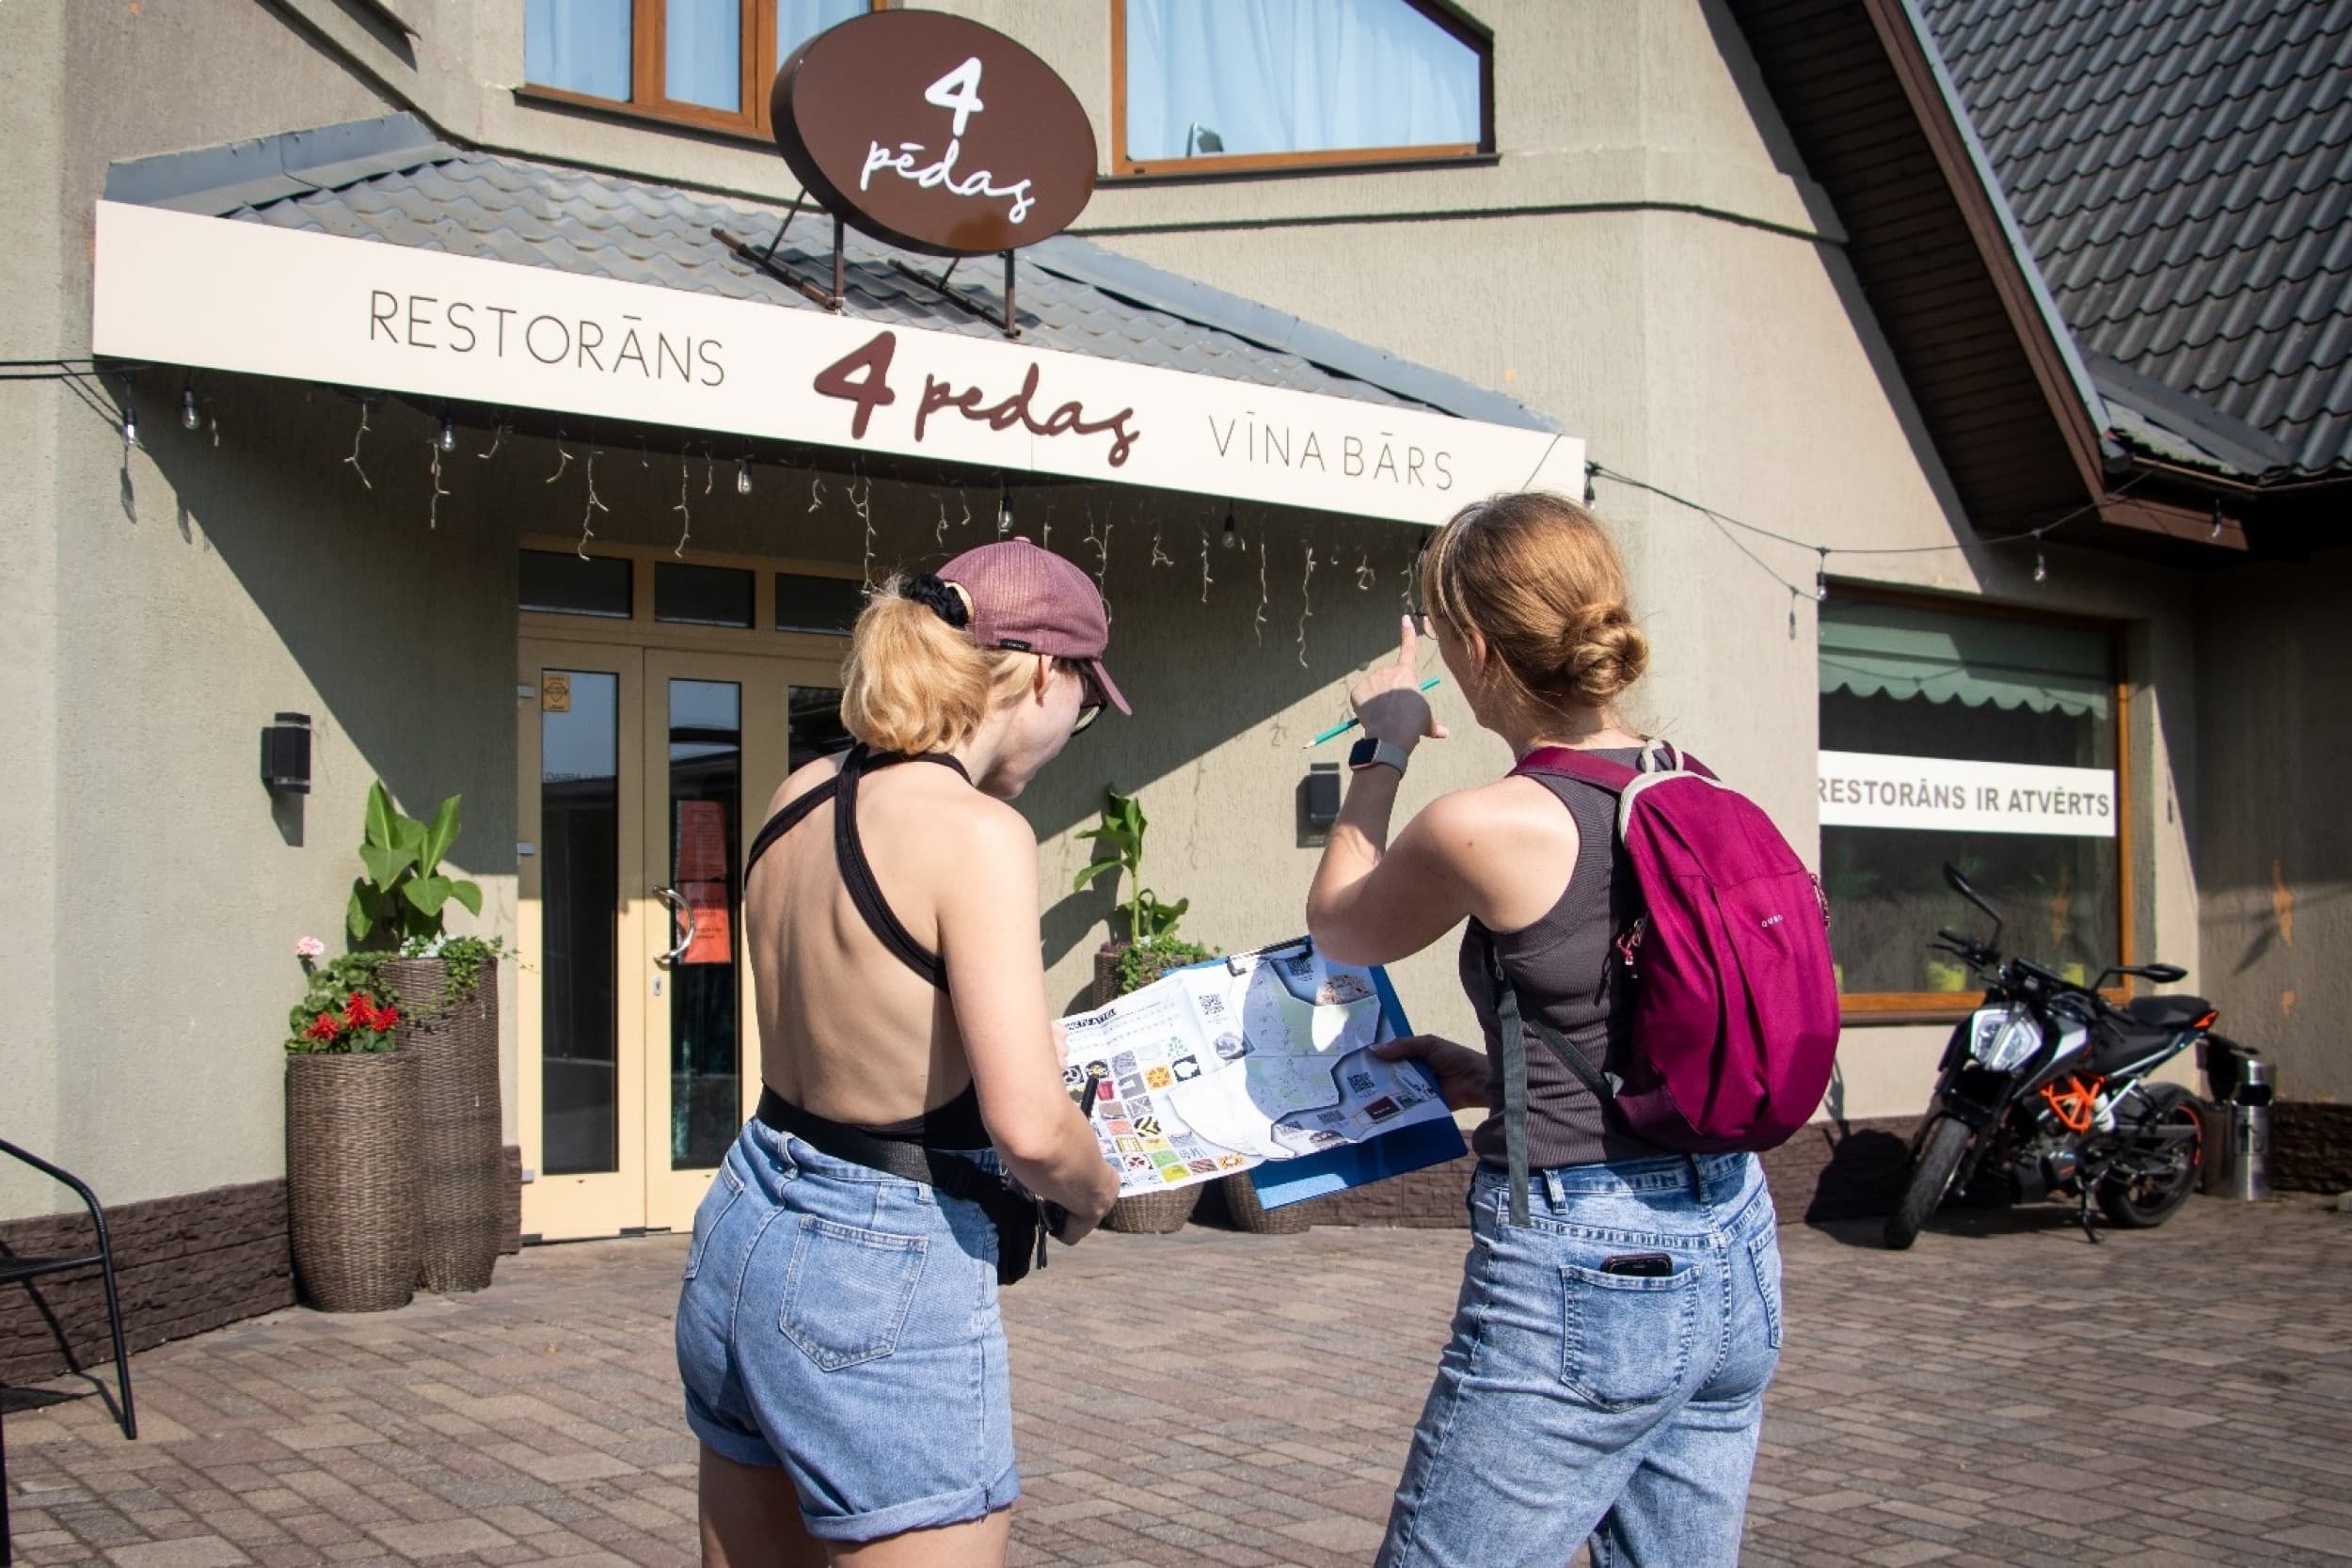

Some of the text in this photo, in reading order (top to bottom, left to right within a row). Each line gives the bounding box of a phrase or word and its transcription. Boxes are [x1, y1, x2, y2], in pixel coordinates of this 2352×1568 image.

[924, 56, 985, 136] 4
[860, 137, 1037, 224] pēdas
[369, 288, 725, 388] RESTORĀNS
[813, 330, 1140, 468] 4 pedas
[1208, 410, 1454, 492] VĪNA BĀRS
[1976, 786, 2000, 812] IR
[2007, 784, 2111, 818] ATVĒRTS
